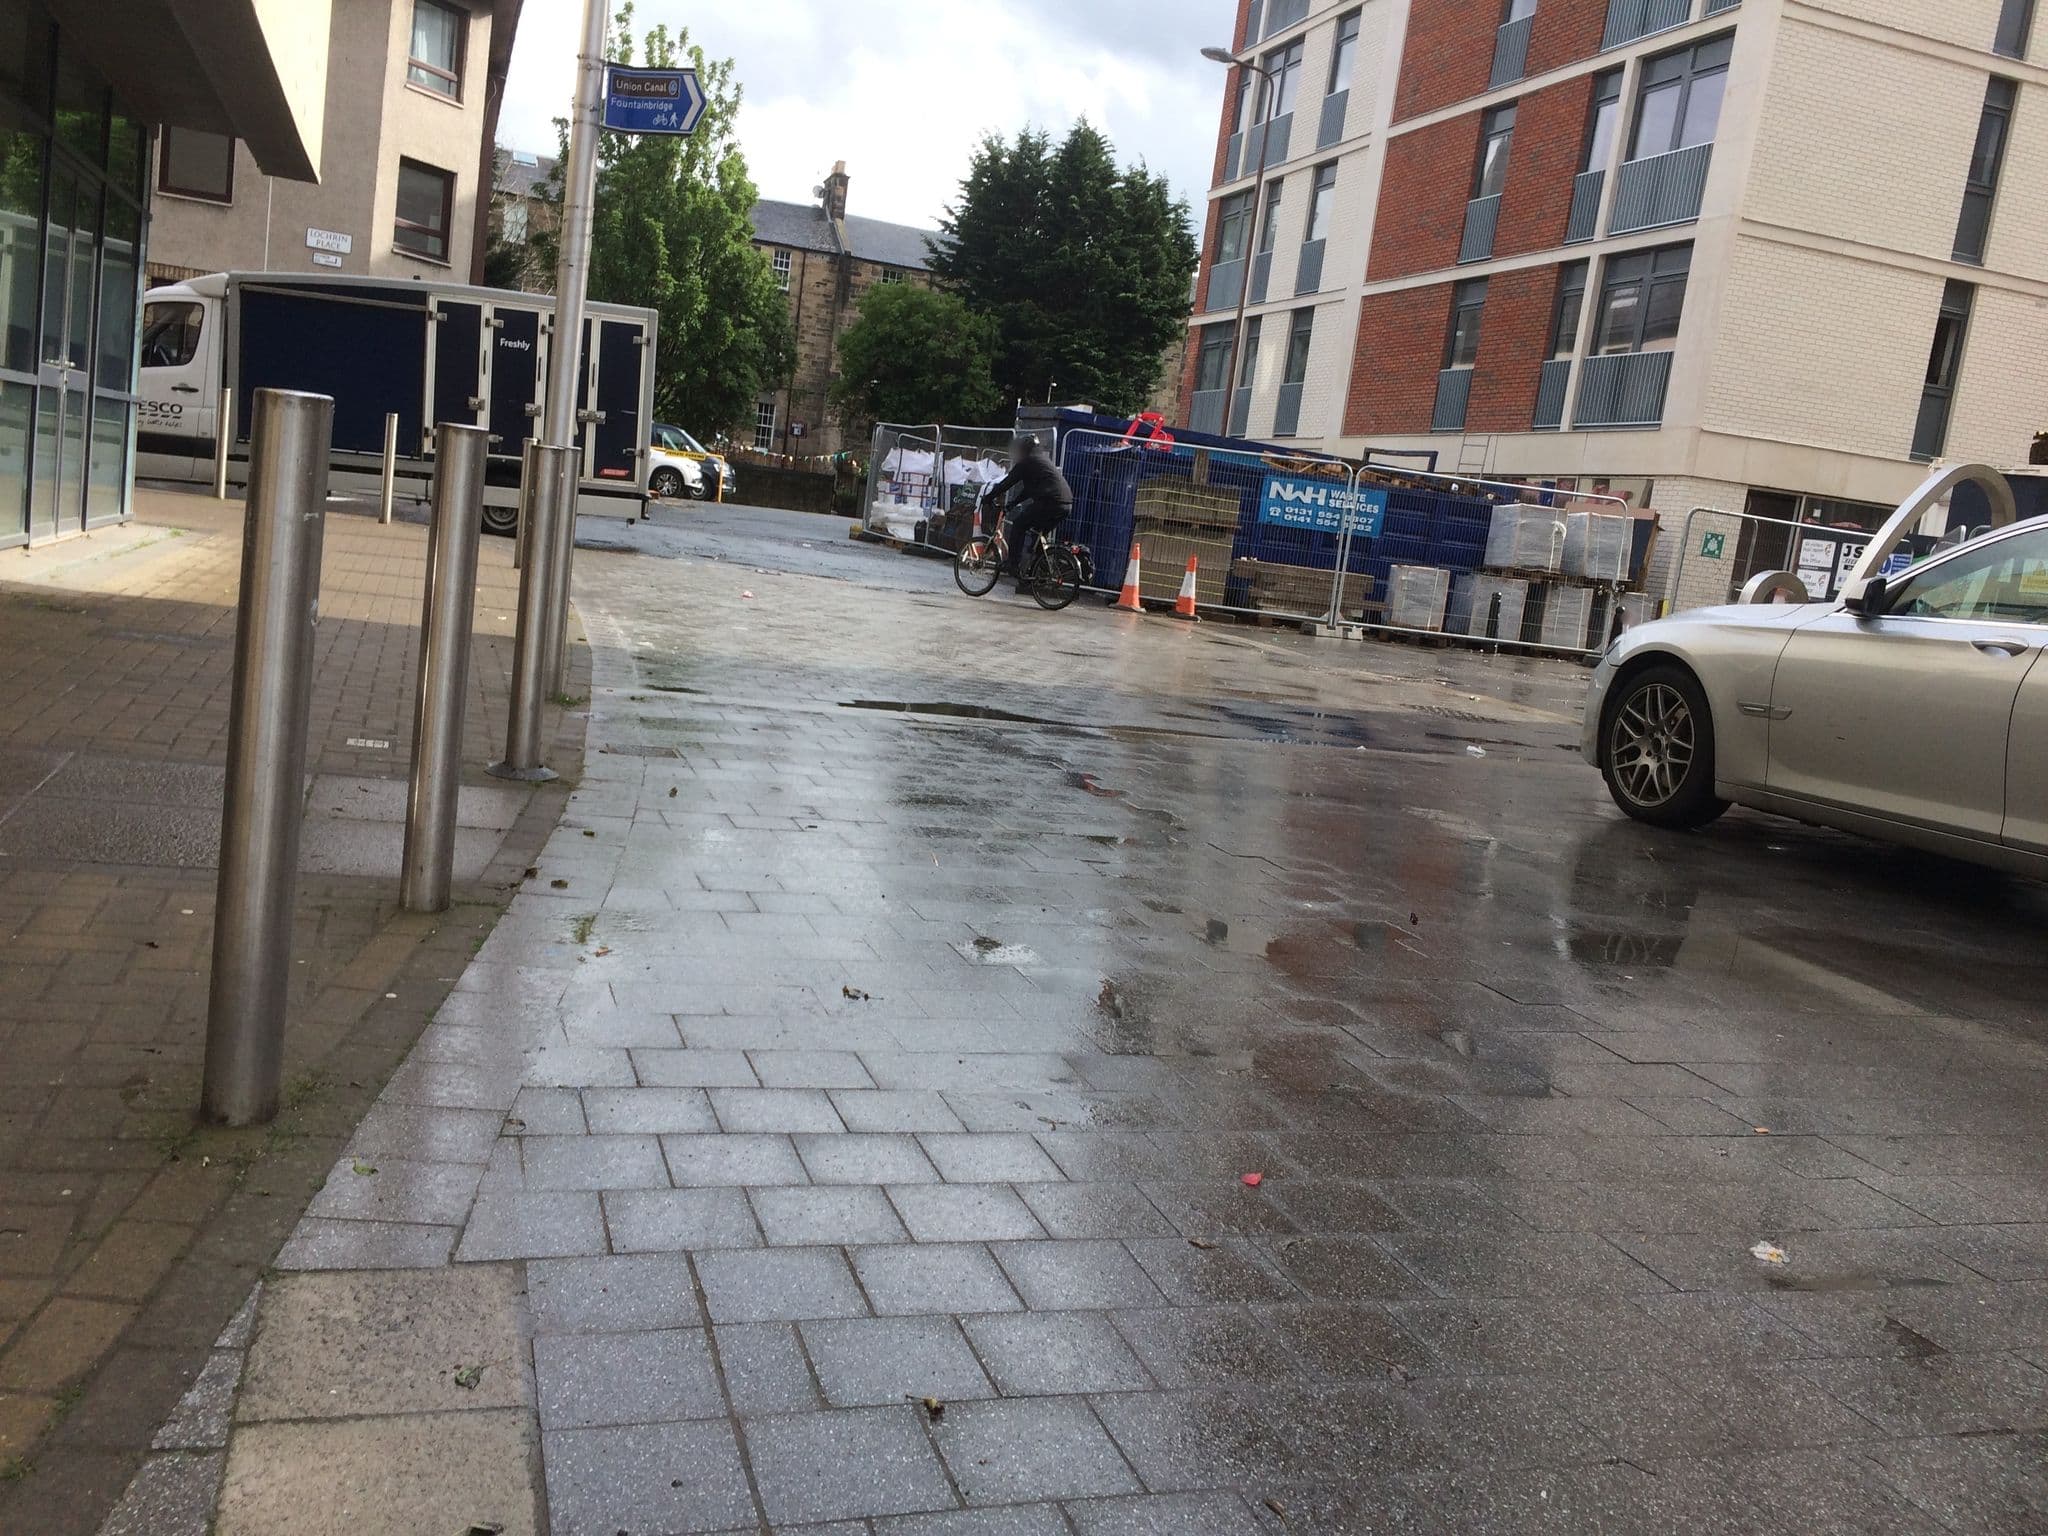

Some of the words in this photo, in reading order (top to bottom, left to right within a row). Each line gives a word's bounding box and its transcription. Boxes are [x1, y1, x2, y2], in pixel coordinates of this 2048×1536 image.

[616, 79, 642, 92] Union
[644, 82, 667, 93] Canal
[610, 97, 674, 111] Fountainbridge
[310, 230, 348, 243] LOCHRIN
[316, 239, 341, 249] PLACE
[500, 337, 531, 351] Freshly
[136, 401, 183, 414] ESCO
[1269, 481, 1327, 506] NWH
[1331, 489, 1367, 502] WASTE
[1285, 507, 1312, 516] 0131
[1284, 514, 1311, 523] 0141
